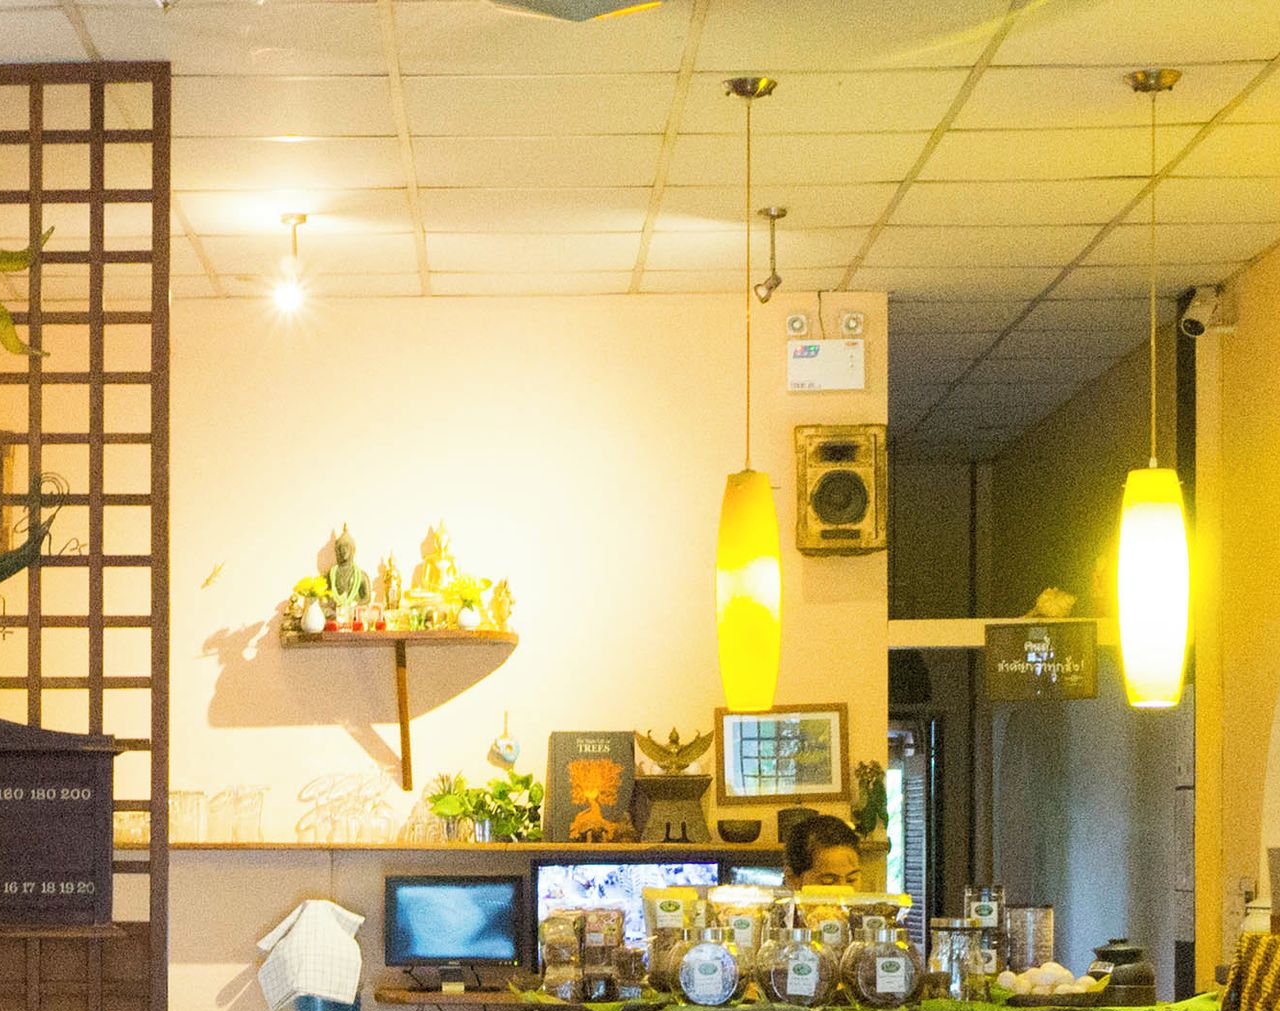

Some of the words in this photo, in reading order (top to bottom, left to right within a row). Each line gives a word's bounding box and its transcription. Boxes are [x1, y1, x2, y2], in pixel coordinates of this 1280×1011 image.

[577, 744, 610, 753] TREES
[30, 787, 56, 801] 180
[60, 787, 91, 801] 200
[3, 881, 18, 894] 16
[22, 881, 36, 894] 17
[40, 881, 56, 894] 18
[59, 881, 74, 894] 19
[76, 881, 95, 894] 20
